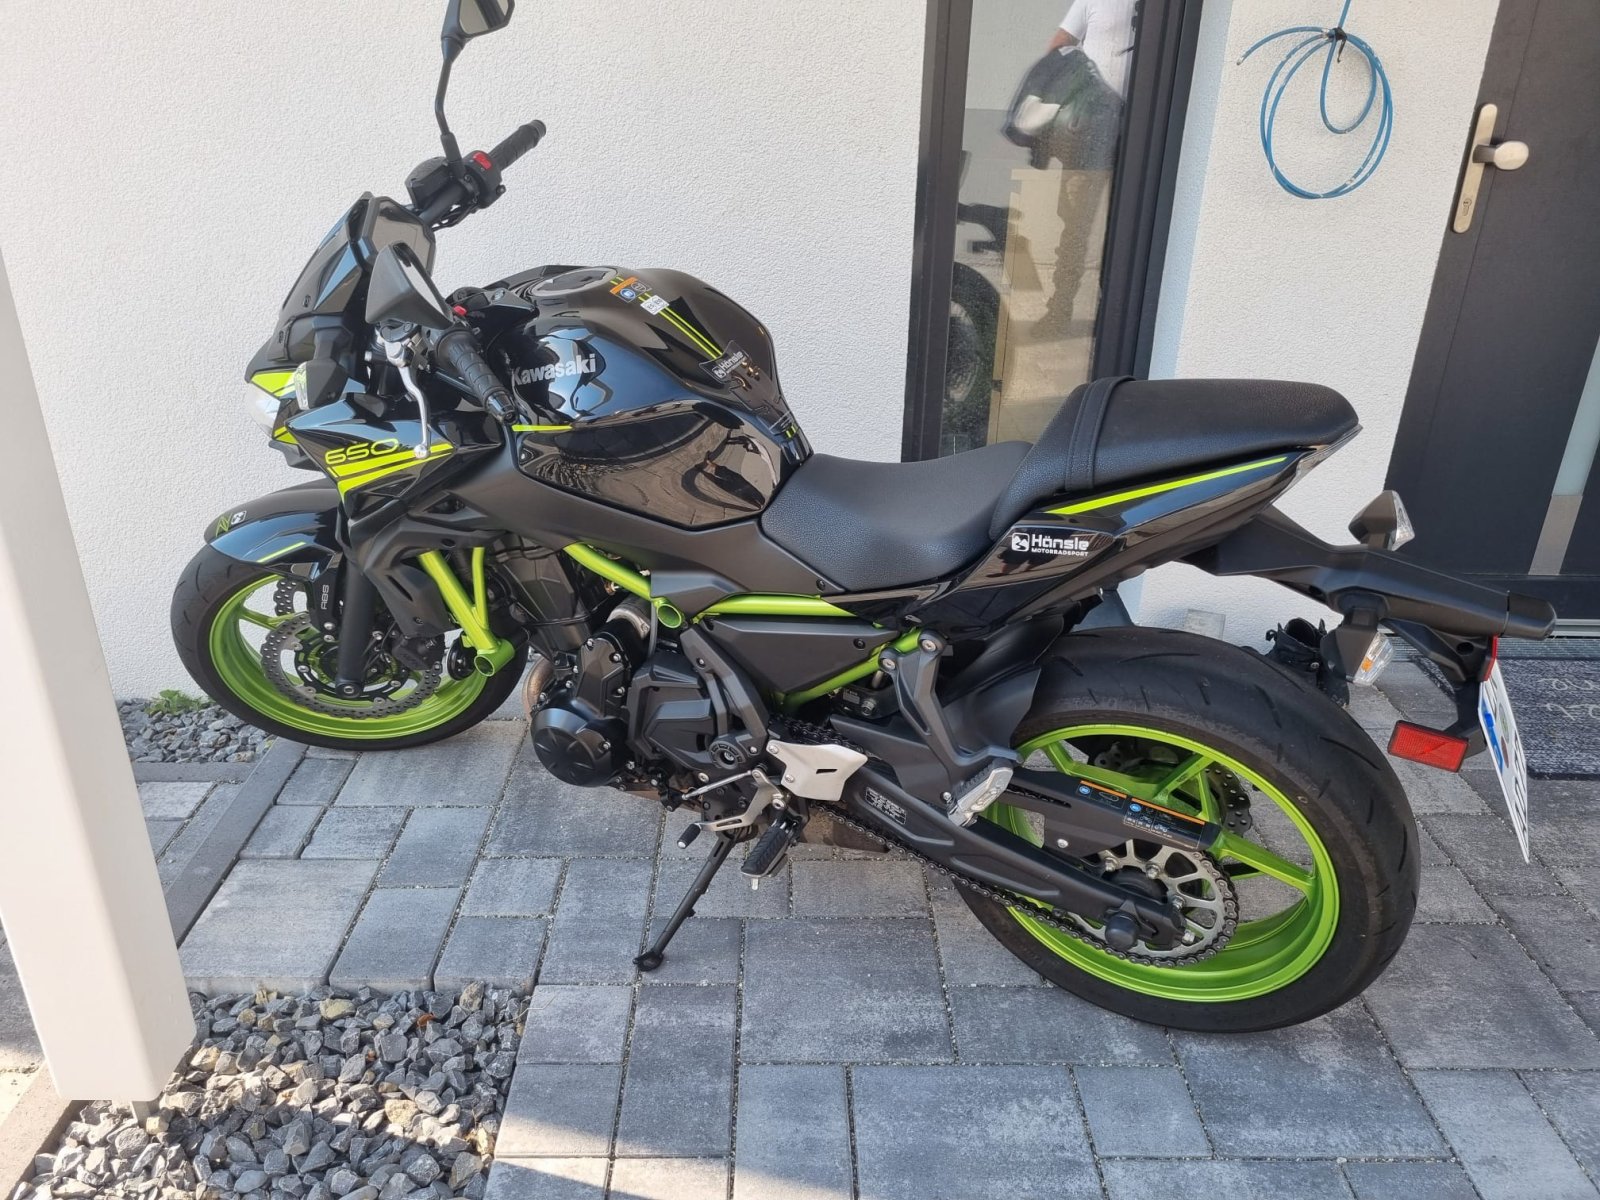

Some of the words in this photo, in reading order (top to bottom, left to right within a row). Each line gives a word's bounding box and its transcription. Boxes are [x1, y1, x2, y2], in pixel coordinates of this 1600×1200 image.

[512, 353, 596, 386] Kawasaki
[325, 438, 399, 465] 650
[1031, 534, 1089, 551] Hänsle
[1031, 547, 1089, 557] MOTORRADSPORT
[321, 584, 330, 610] ABS
